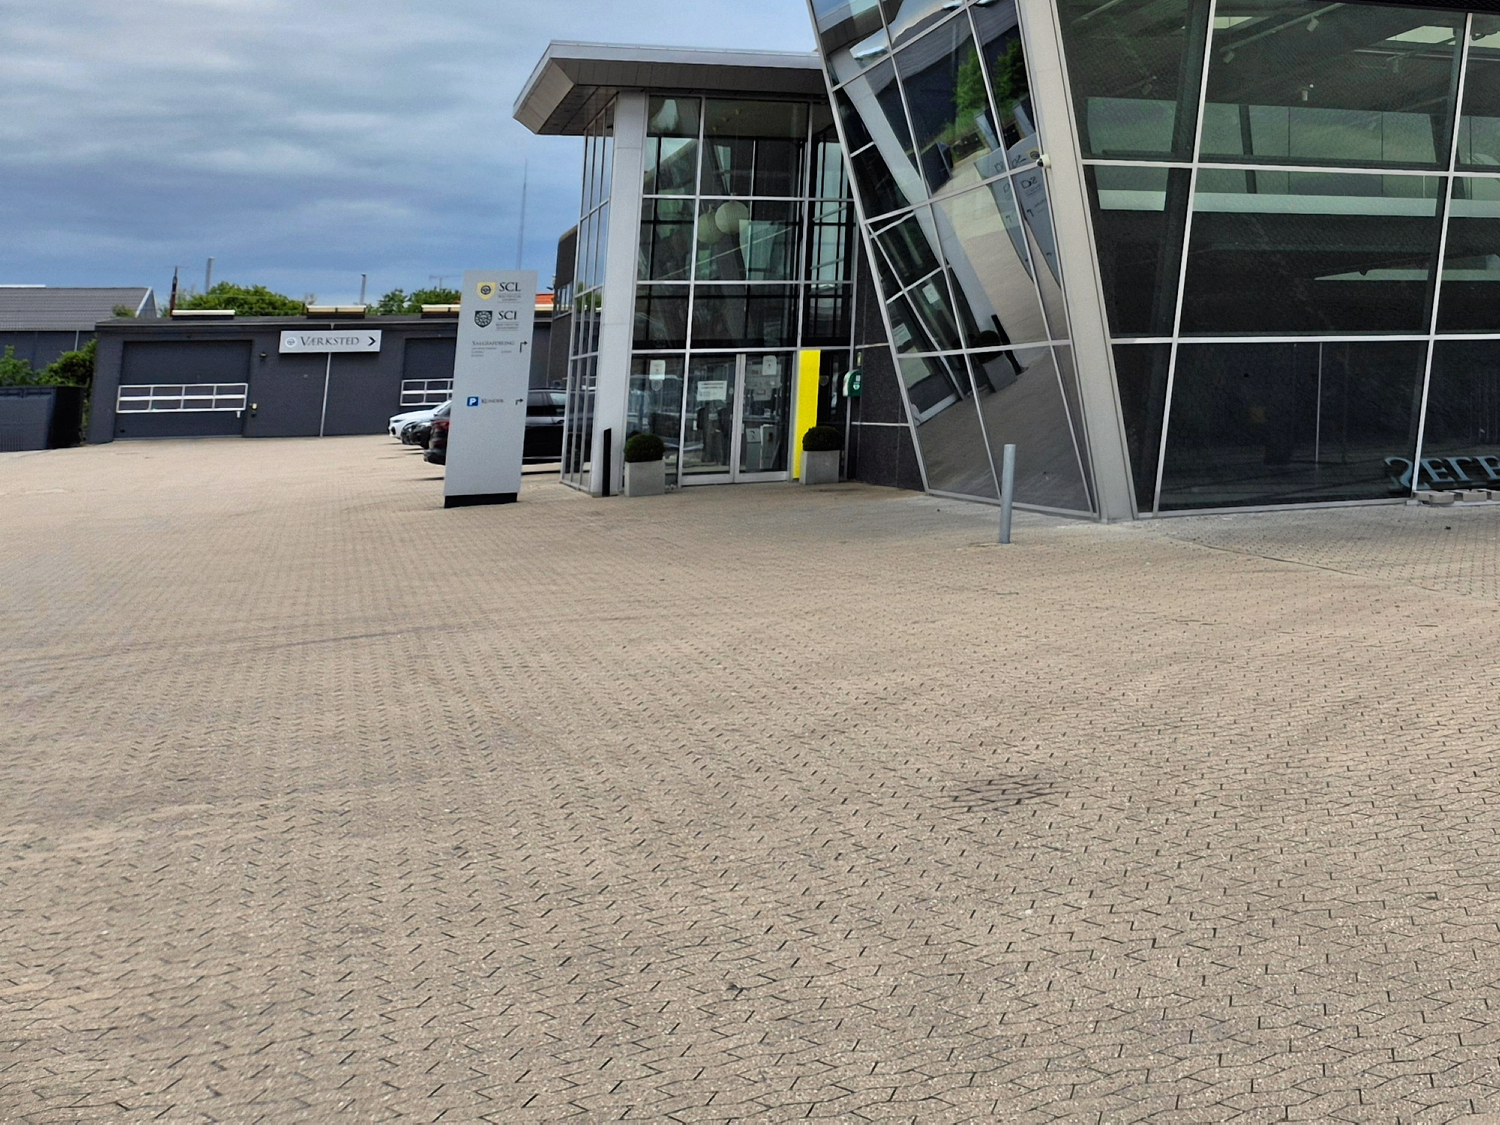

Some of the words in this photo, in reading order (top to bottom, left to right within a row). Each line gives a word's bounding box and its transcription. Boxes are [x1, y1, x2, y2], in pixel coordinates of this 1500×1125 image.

[498, 281, 522, 292] SCL
[497, 310, 518, 320] SCI
[300, 336, 360, 346] VÆRKSTED
